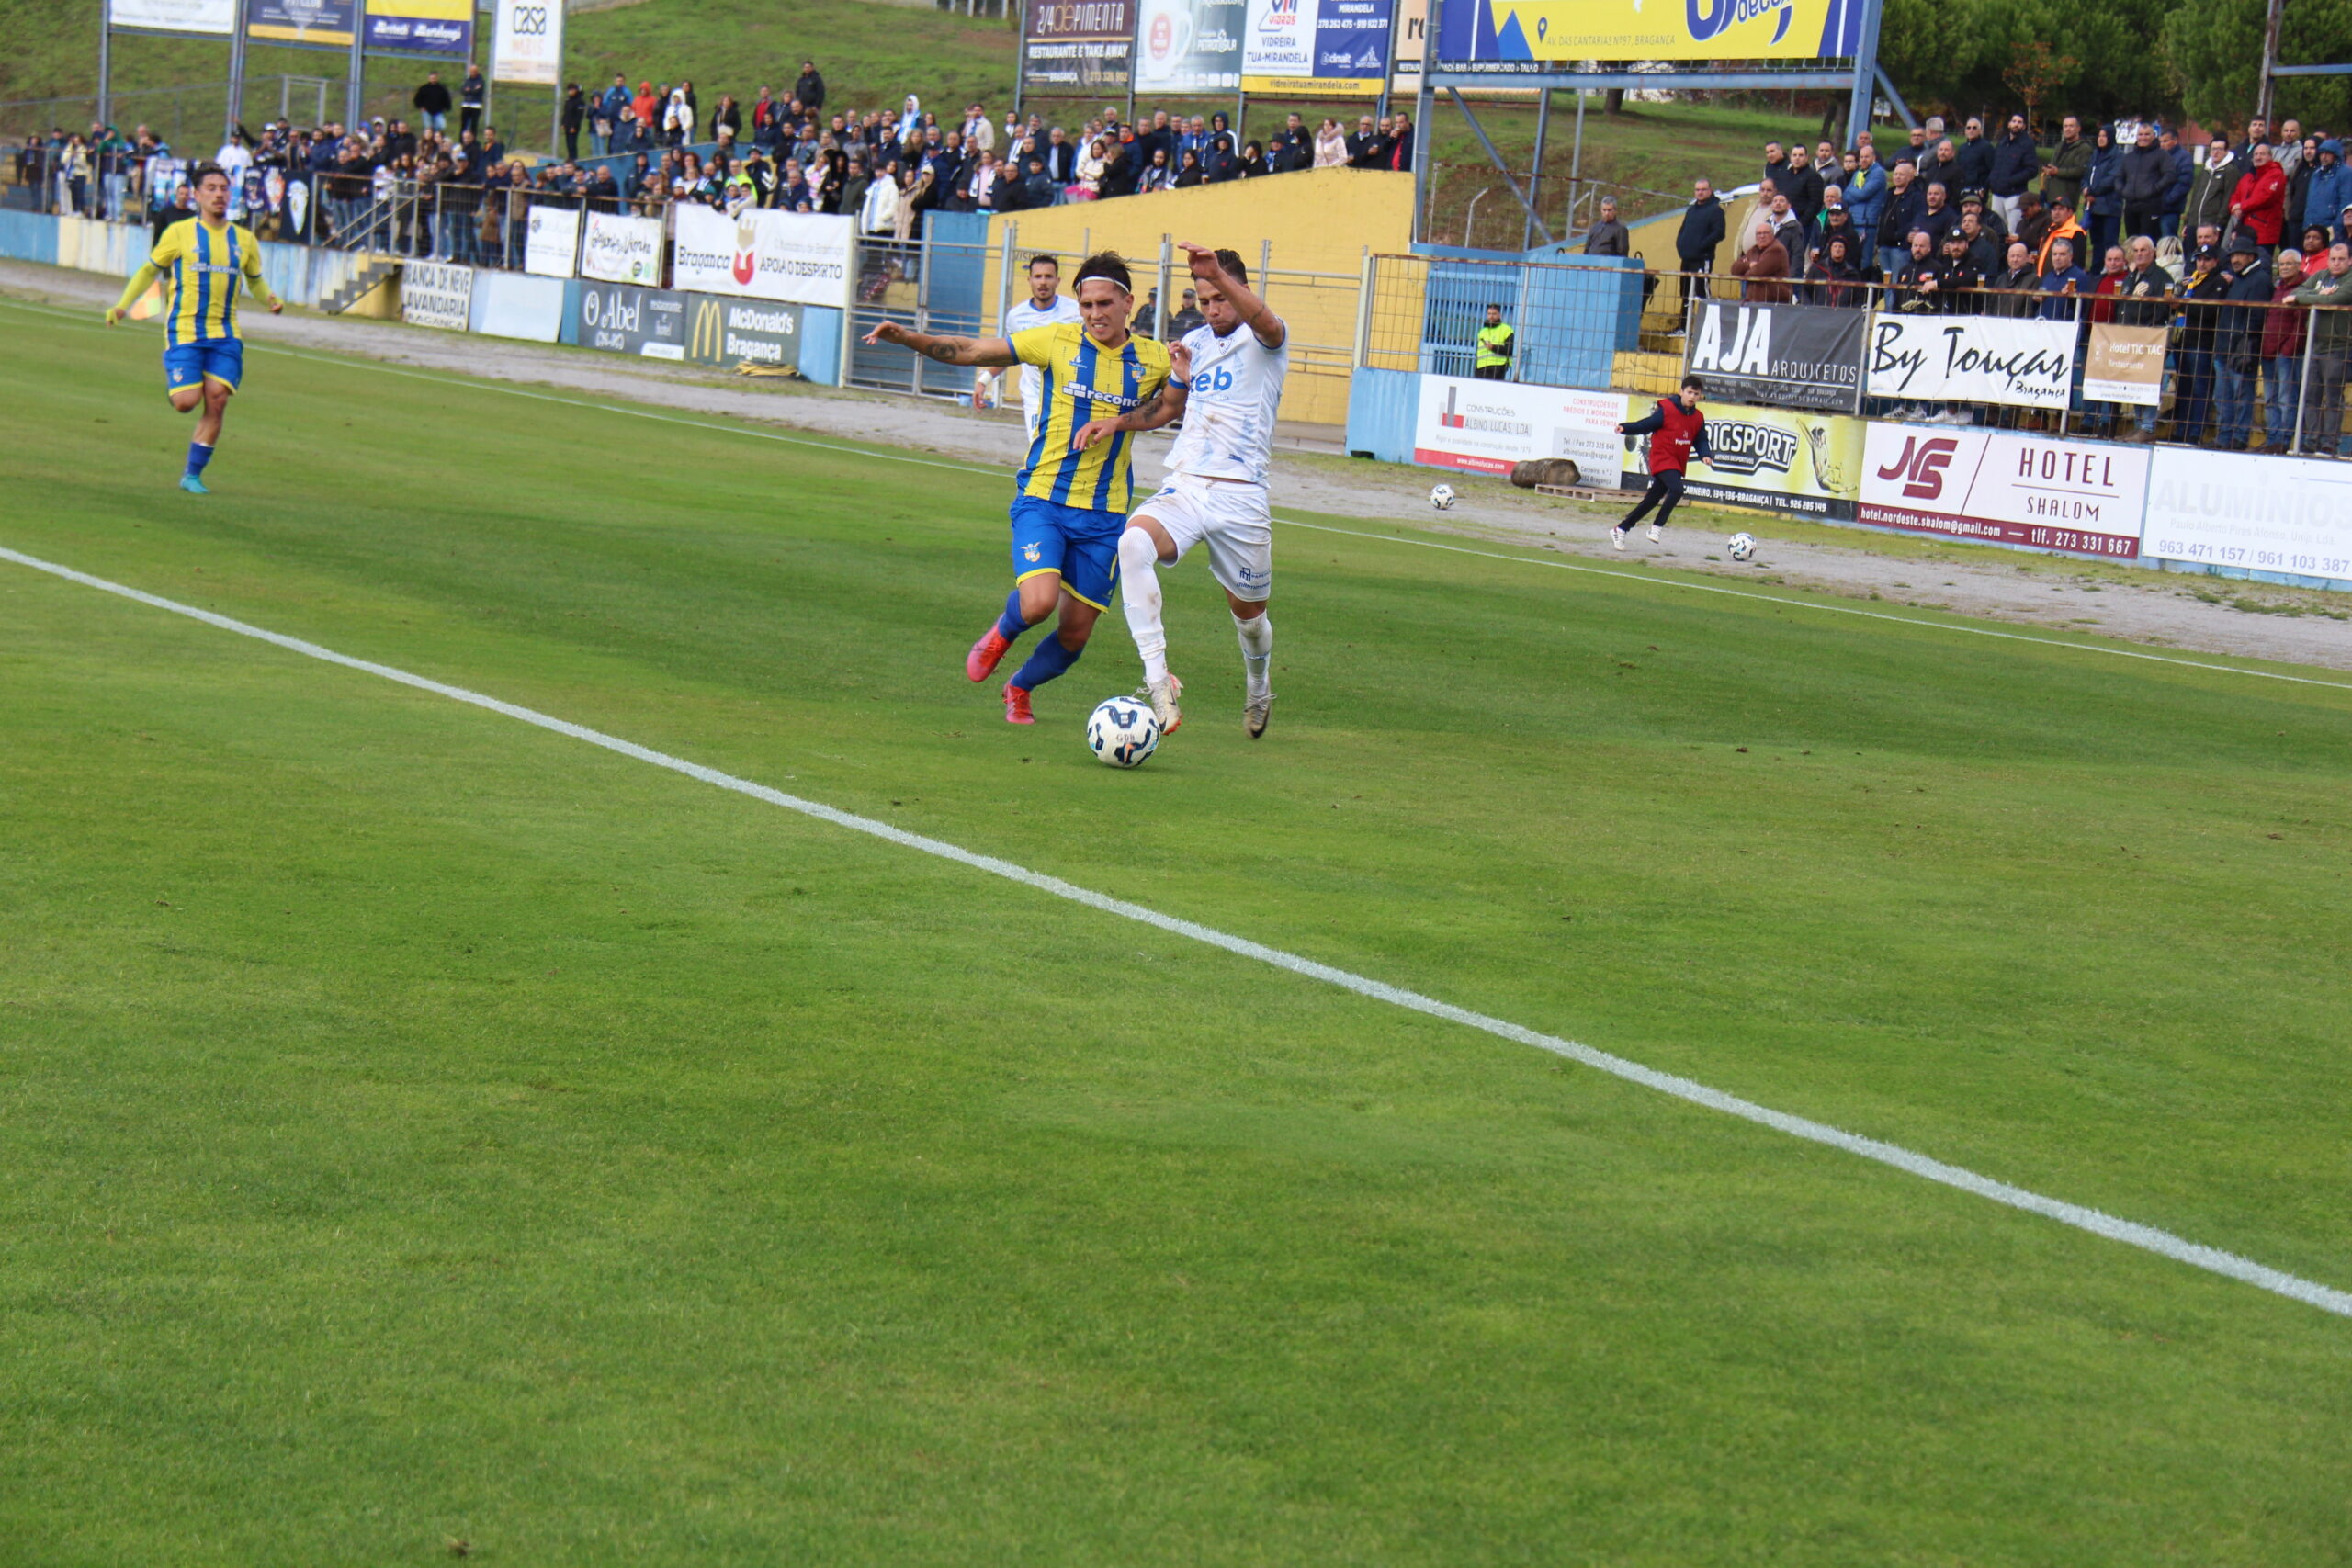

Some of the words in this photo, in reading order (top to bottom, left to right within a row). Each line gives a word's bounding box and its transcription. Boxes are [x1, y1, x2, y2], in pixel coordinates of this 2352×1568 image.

[1073, 3, 1124, 32] PIMENTA
[1339, 4, 1374, 14] MIRANDELA
[1261, 37, 1296, 48] VIDREIRA
[1560, 35, 1572, 46] DAS
[1573, 35, 1612, 46] CANTARIAS
[1635, 34, 1676, 47] BRAGANÇA
[1028, 44, 1077, 59] RESTAURANTE
[1078, 45, 1084, 59] E
[1085, 45, 1104, 59] TAKE
[1105, 44, 1129, 58] AWAY
[1247, 51, 1308, 64] TUA-MIRANDELA
[1398, 63, 1421, 72] RESTAUR
[1270, 79, 1360, 91] vidreiratuamirandela.com
[678, 245, 730, 275] Bragança
[583, 290, 600, 326] O
[601, 291, 642, 332] Abel
[729, 306, 794, 335] McDonald's
[726, 332, 782, 362] Bragança
[1691, 304, 1771, 376] AJA
[2109, 342, 2131, 354] Hotel
[2132, 344, 2144, 355] TIC
[2146, 344, 2163, 355] TAC
[1871, 321, 1928, 392] By
[1942, 327, 2069, 391] Touças
[1770, 359, 1857, 383] ARQUITETOS
[2016, 379, 2066, 399] Bragança
[1465, 403, 1516, 418] CONSTRUÇÕES
[1464, 417, 1487, 432] ALBINO
[1456, 457, 1505, 470] www.albinolucas.com
[2018, 447, 2115, 487] HOTEL
[1775, 496, 1789, 508] TEL.
[1790, 498, 1801, 509] 926
[1815, 501, 1827, 513] 149
[2026, 496, 2100, 522] SHALOM
[1860, 506, 2001, 537] hotel.nordeste.shalom@gmail.com
[2055, 531, 2077, 548] 273
[2082, 534, 2103, 552] 331
[2108, 537, 2131, 555] 667
[2196, 520, 2227, 535] Alberto
[2229, 523, 2252, 537] Pires
[2159, 539, 2184, 555] 963
[2188, 543, 2213, 558] 471
[2220, 547, 2245, 561] 157
[2257, 550, 2284, 567] 961
[2291, 554, 2316, 570] 103
[2322, 558, 2350, 574] 387
